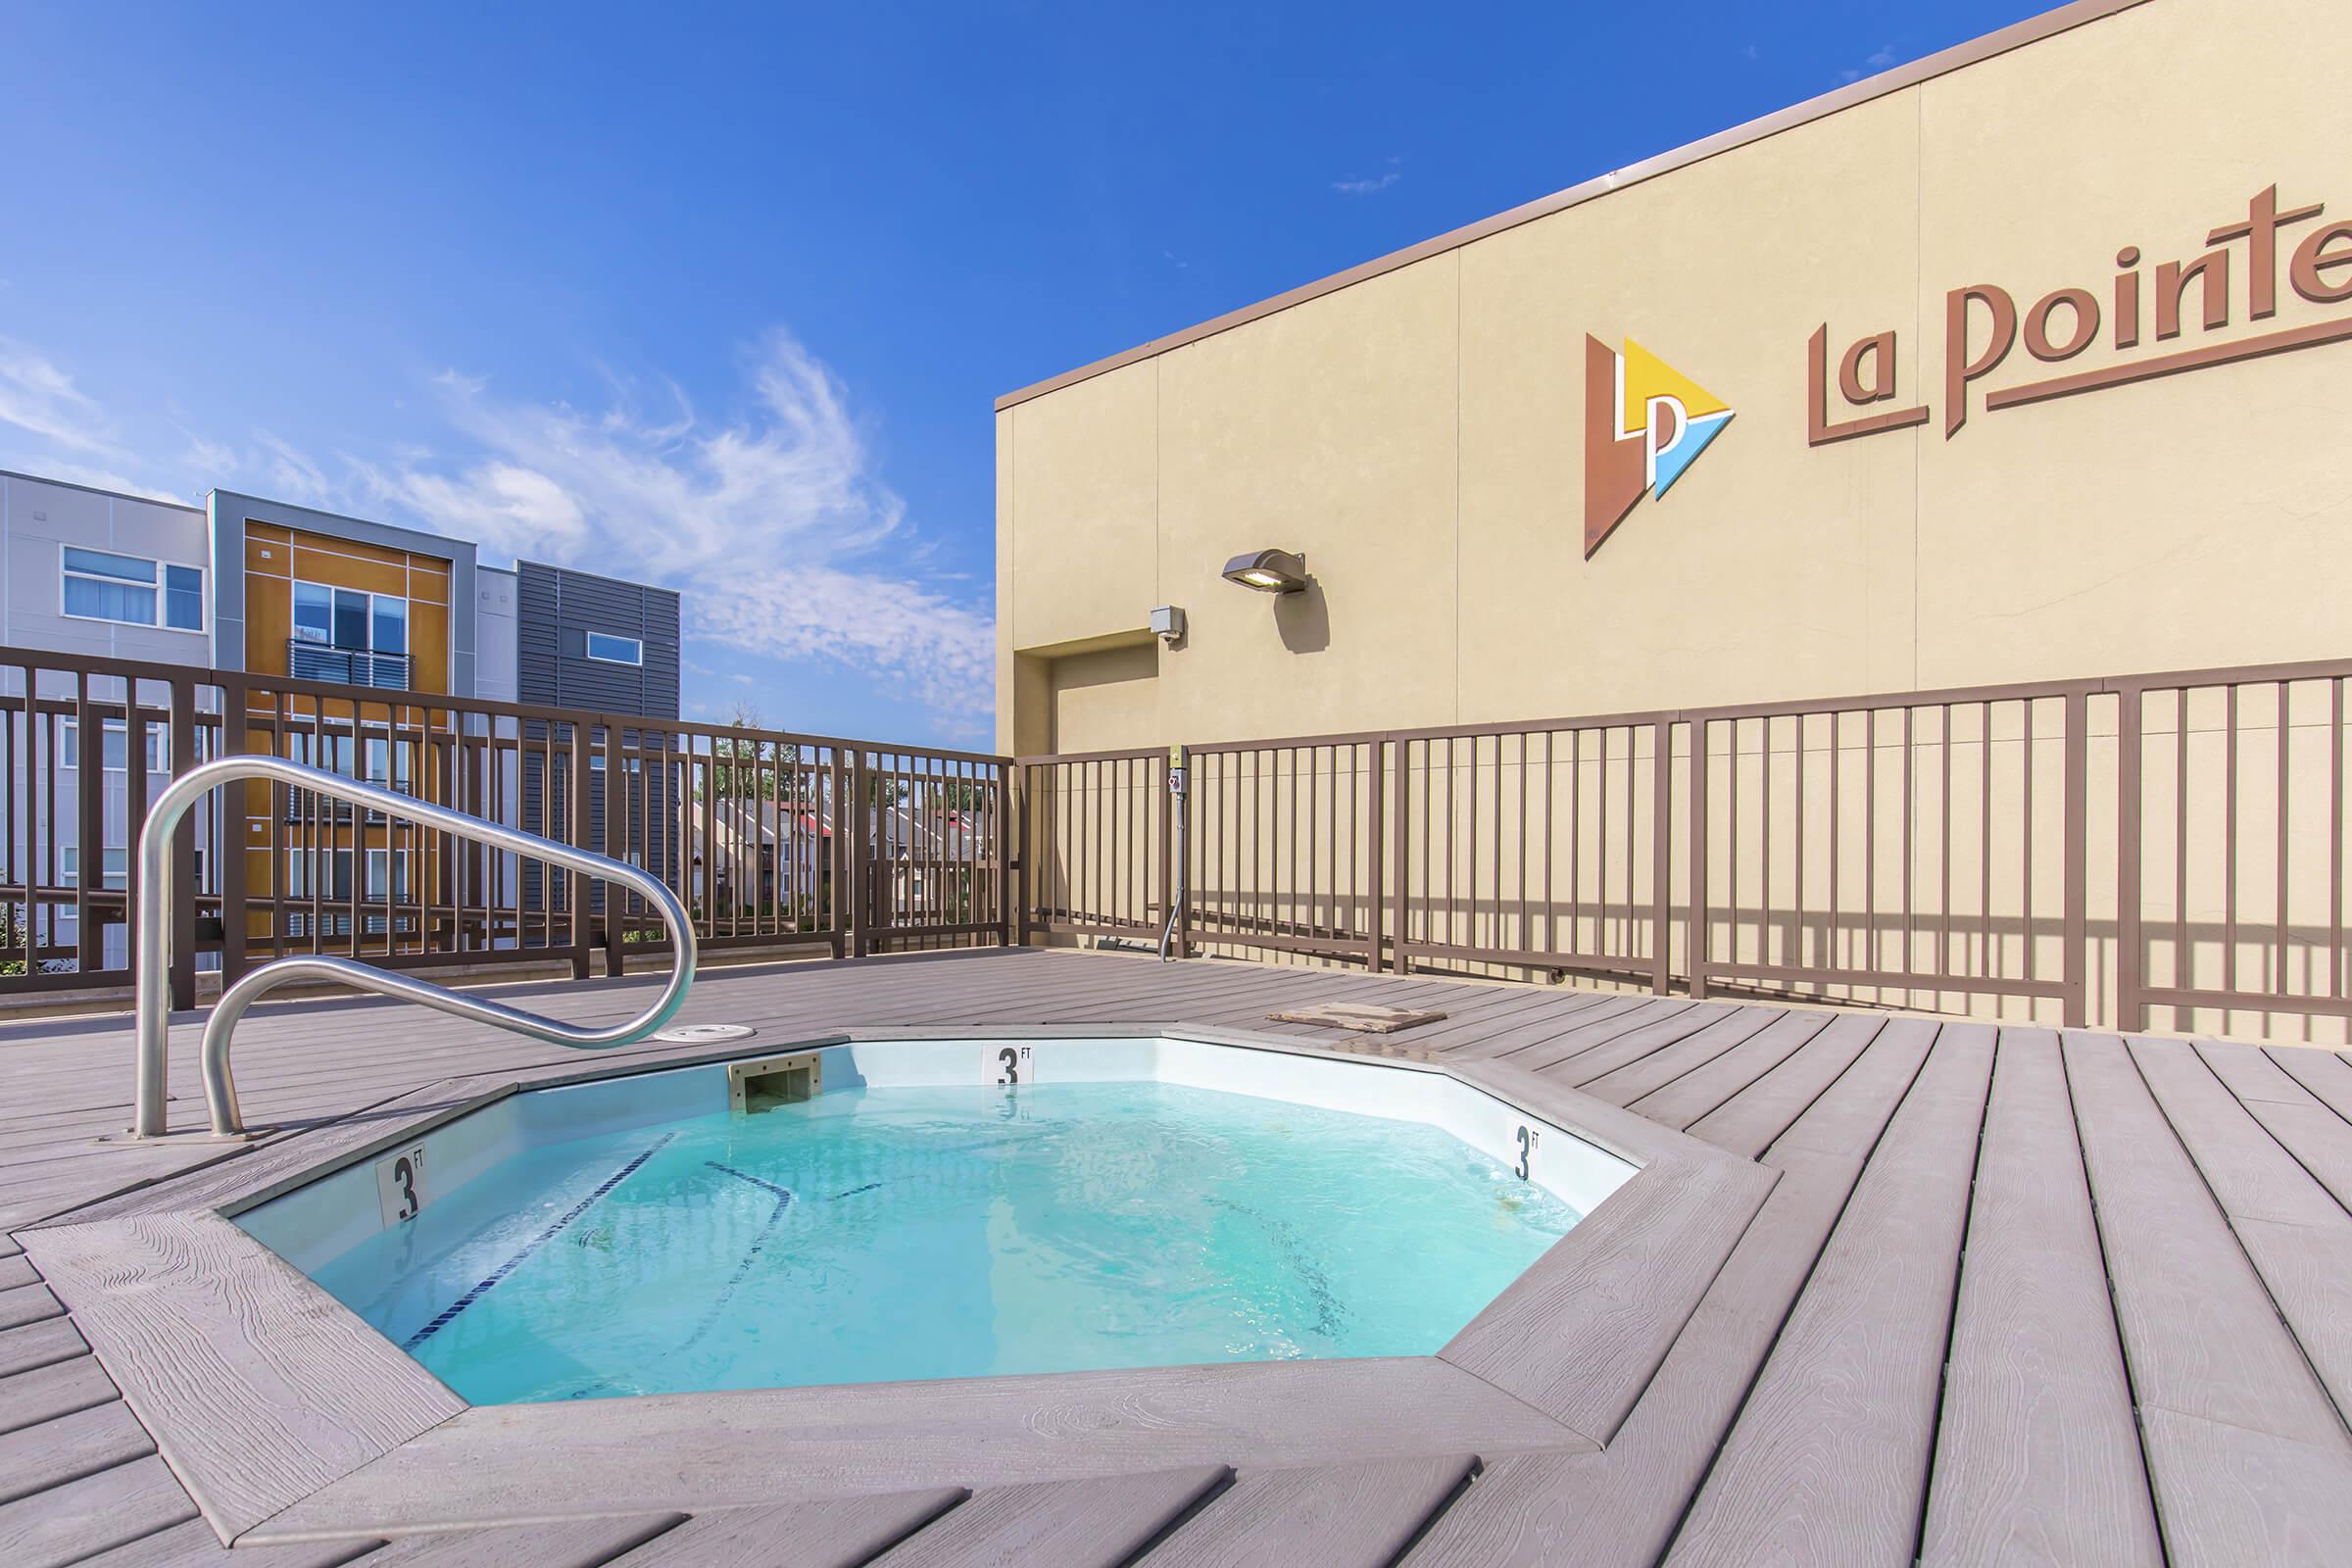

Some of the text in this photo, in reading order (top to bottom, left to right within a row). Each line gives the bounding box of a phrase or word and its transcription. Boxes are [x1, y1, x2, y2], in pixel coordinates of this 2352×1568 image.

[1808, 321, 1930, 447] La
[1615, 352, 1689, 490] LP
[998, 1047, 1031, 1084] 3 FT
[394, 1149, 423, 1221] 3 FT
[1515, 1125, 1540, 1182] 3 FT
